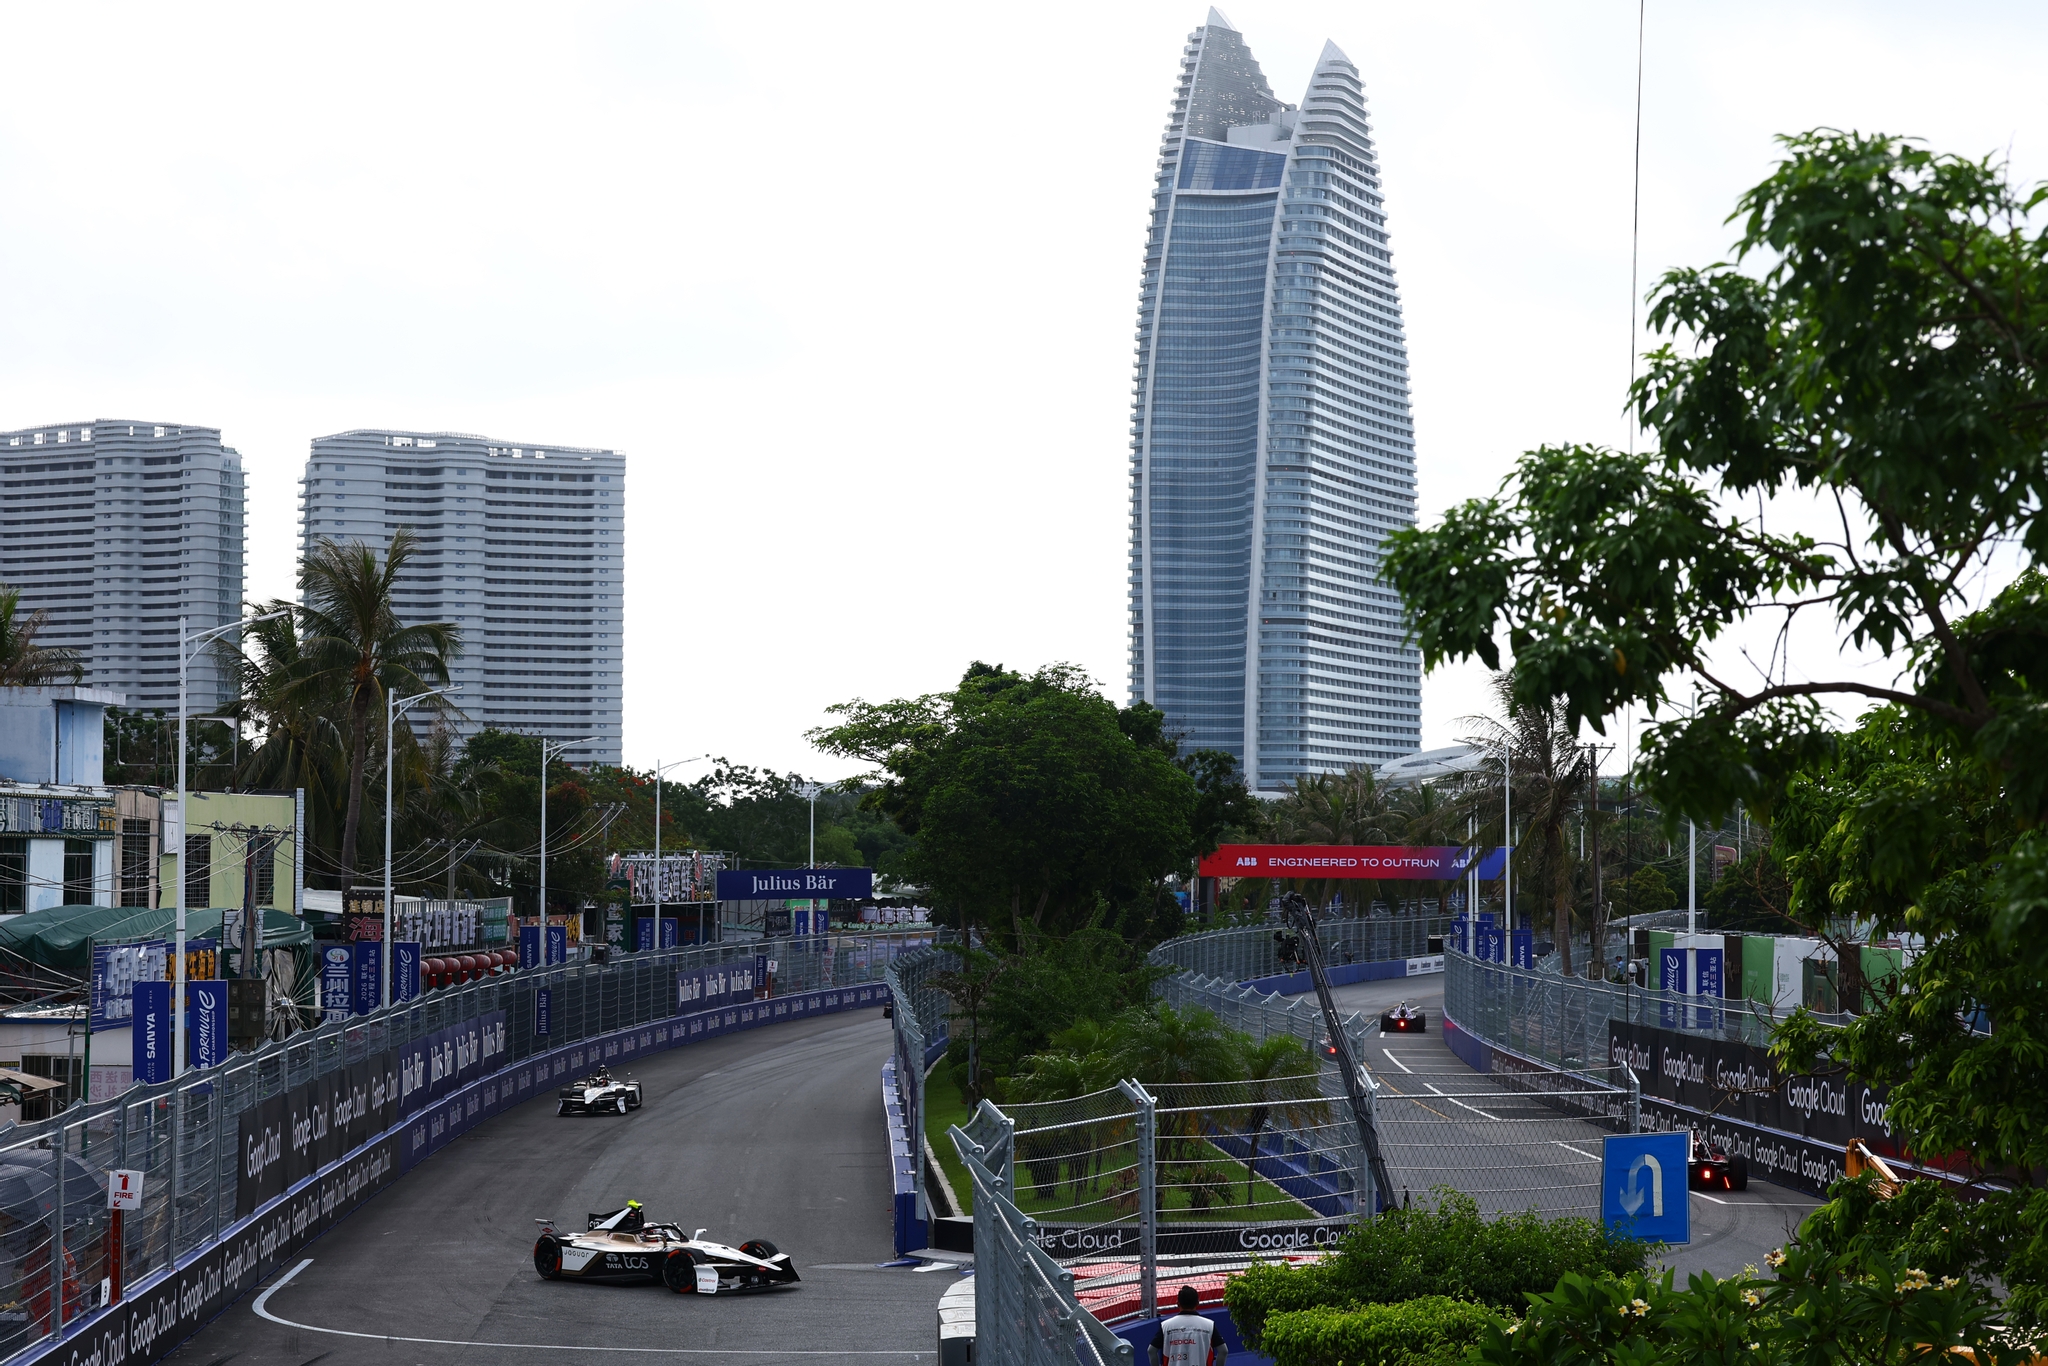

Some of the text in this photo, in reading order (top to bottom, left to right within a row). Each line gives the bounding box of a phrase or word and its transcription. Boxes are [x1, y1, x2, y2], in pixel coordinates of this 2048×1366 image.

[1236, 857, 1258, 866] ABB
[1268, 858, 1358, 867] ENGINEERED
[1361, 858, 1380, 867] TO
[1382, 858, 1440, 868] OUTRUN
[752, 875, 836, 894] Julius Bär
[326, 964, 350, 1022] 兰州拉面
[679, 979, 692, 1008] Julius
[705, 973, 726, 1001] Julius Bär
[730, 970, 752, 997] Julius Bär
[146, 1012, 156, 1059] SANYA
[199, 1008, 210, 1062] FORMULA
[539, 1013, 548, 1034] Julius
[1633, 1044, 1650, 1070] Cloud
[1663, 1046, 1704, 1087] Google Cloud
[1716, 1058, 1770, 1100] Google Cloud
[1787, 1073, 1846, 1119] Google Cloud
[1640, 1108, 1656, 1132] oogle
[370, 1145, 391, 1184] Google Cloud
[1733, 1132, 1751, 1159] Cloud
[1754, 1137, 1798, 1173] Google Cloud
[347, 1158, 369, 1200] Google Cloud
[1801, 1149, 1828, 1189] Google
[292, 1190, 319, 1239] Google Cloud
[321, 1174, 346, 1219] Google Cloud
[260, 1210, 290, 1263] Google Cloud
[1062, 1229, 1122, 1248] Cloud
[1240, 1229, 1309, 1252] Google
[224, 1232, 258, 1290] Google Cloud
[622, 1254, 649, 1269] tcs
[180, 1258, 221, 1321] Google Cloud
[130, 1302, 156, 1356] Google
[157, 1288, 177, 1335] Cloud
